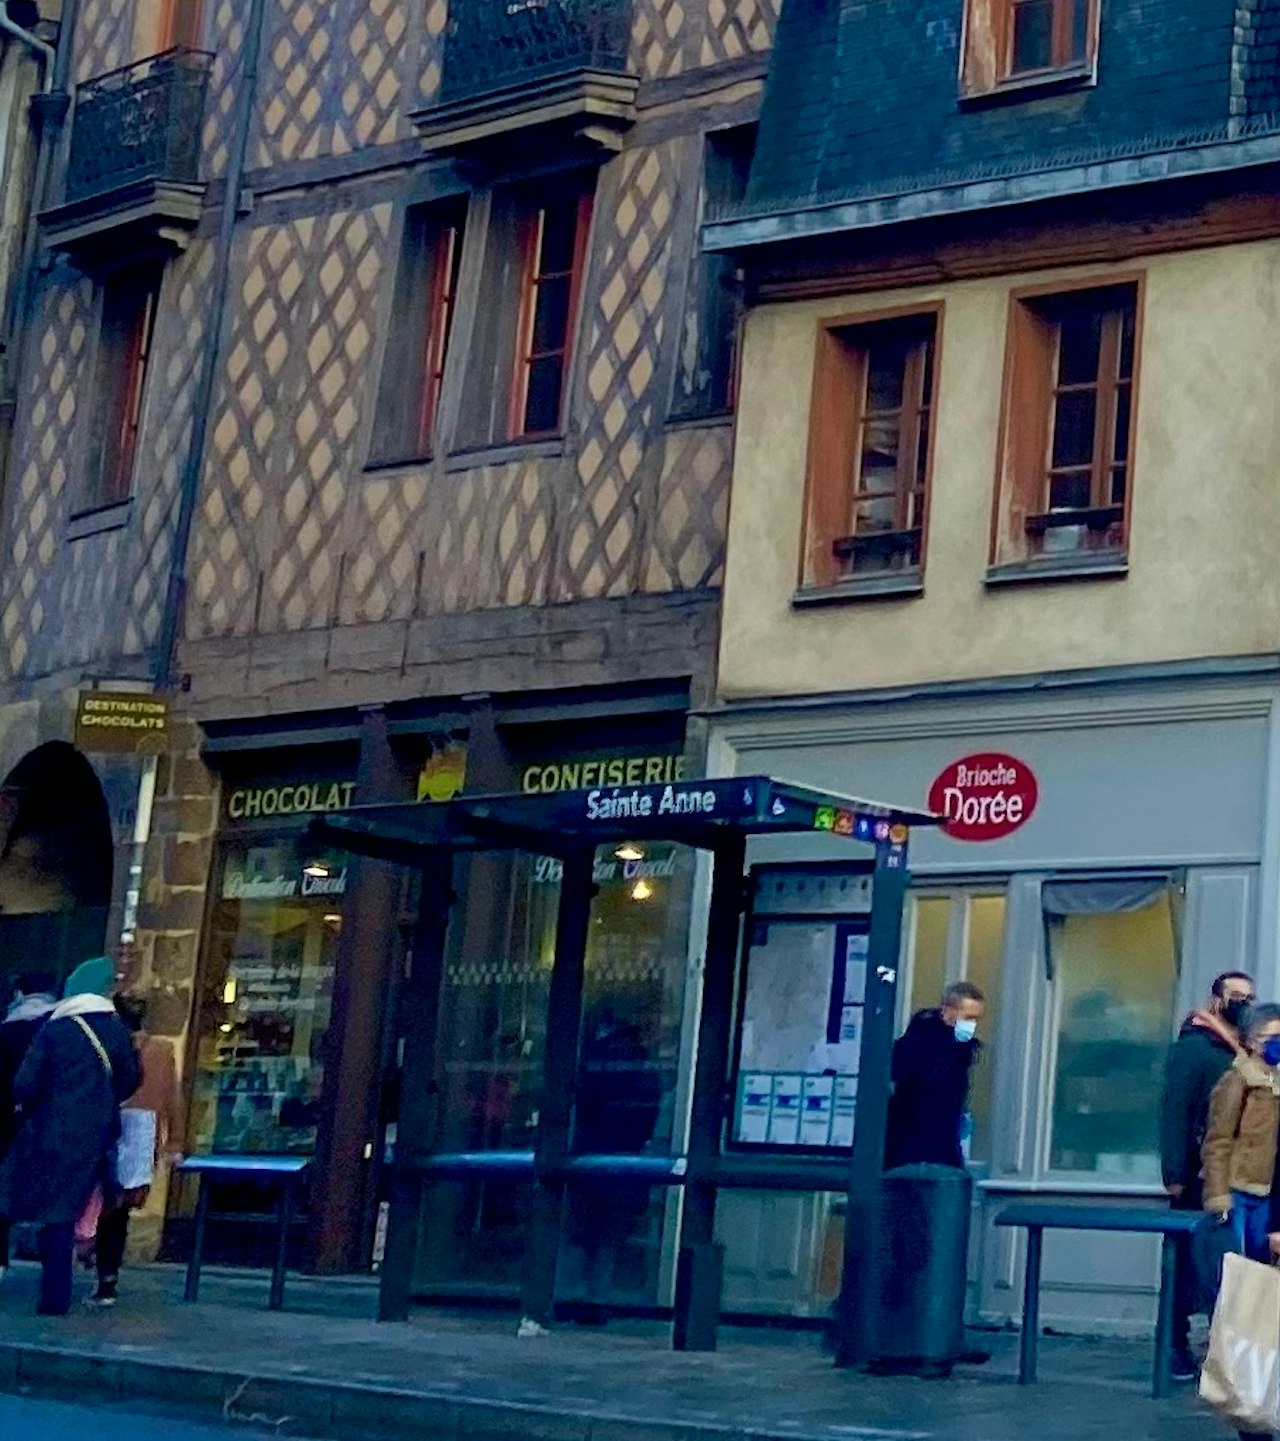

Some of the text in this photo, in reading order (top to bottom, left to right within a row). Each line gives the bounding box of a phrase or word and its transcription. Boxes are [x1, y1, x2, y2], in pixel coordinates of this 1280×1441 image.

[84, 700, 166, 713] DESTINATION
[81, 714, 165, 728] CHOCOLATS
[956, 762, 1016, 787] Brioche
[586, 785, 717, 819] Sainte Anne
[944, 787, 1023, 825] Dorée
